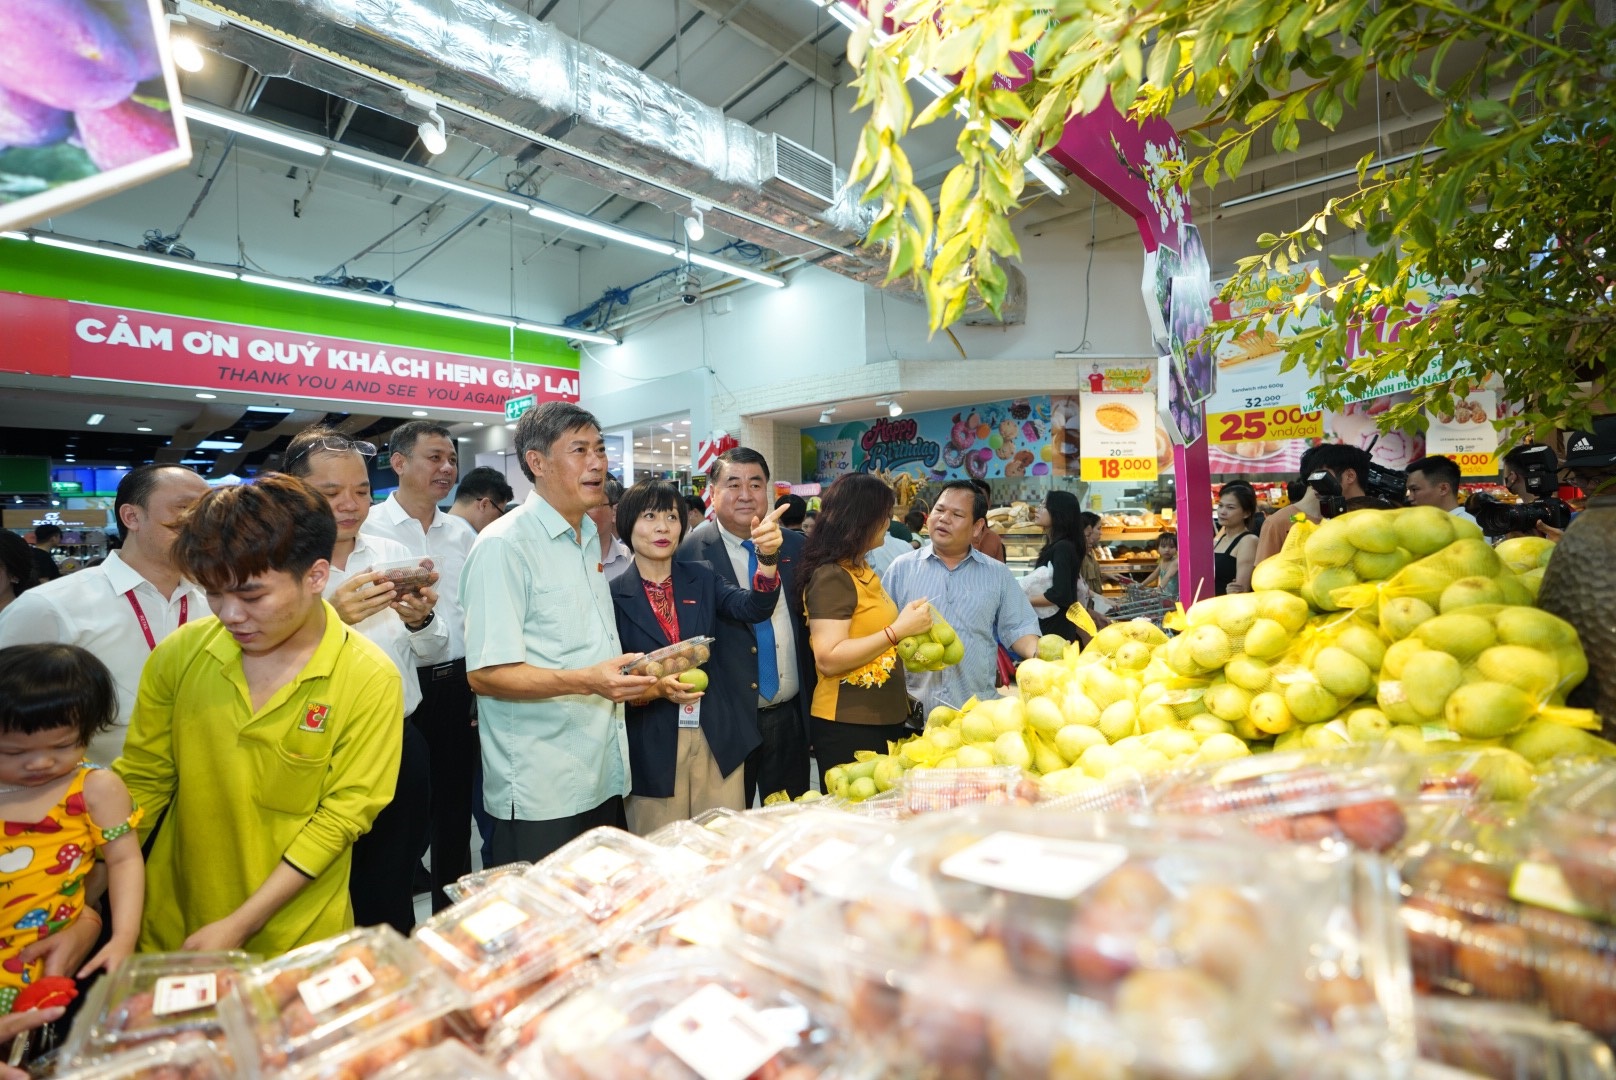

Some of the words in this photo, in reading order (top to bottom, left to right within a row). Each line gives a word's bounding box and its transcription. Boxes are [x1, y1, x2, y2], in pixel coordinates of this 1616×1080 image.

[75, 315, 173, 351] CẢM
[182, 331, 239, 358] ƠN
[247, 340, 321, 367] QUÝ
[328, 349, 429, 380] KHÁCH
[436, 363, 487, 387] HẸN
[492, 369, 541, 393] GẶP
[545, 375, 579, 398] LẠI
[218, 366, 290, 386] THANK
[297, 375, 337, 390] YOU
[342, 380, 381, 394] AND
[386, 384, 418, 398] SEE
[427, 388, 459, 402] YOU
[464, 391, 511, 406] AGAIN
[862, 417, 917, 450] Happy
[1270, 424, 1317, 437] vnd/gói
[824, 450, 847, 460] Happy
[862, 437, 940, 470] Birthday
